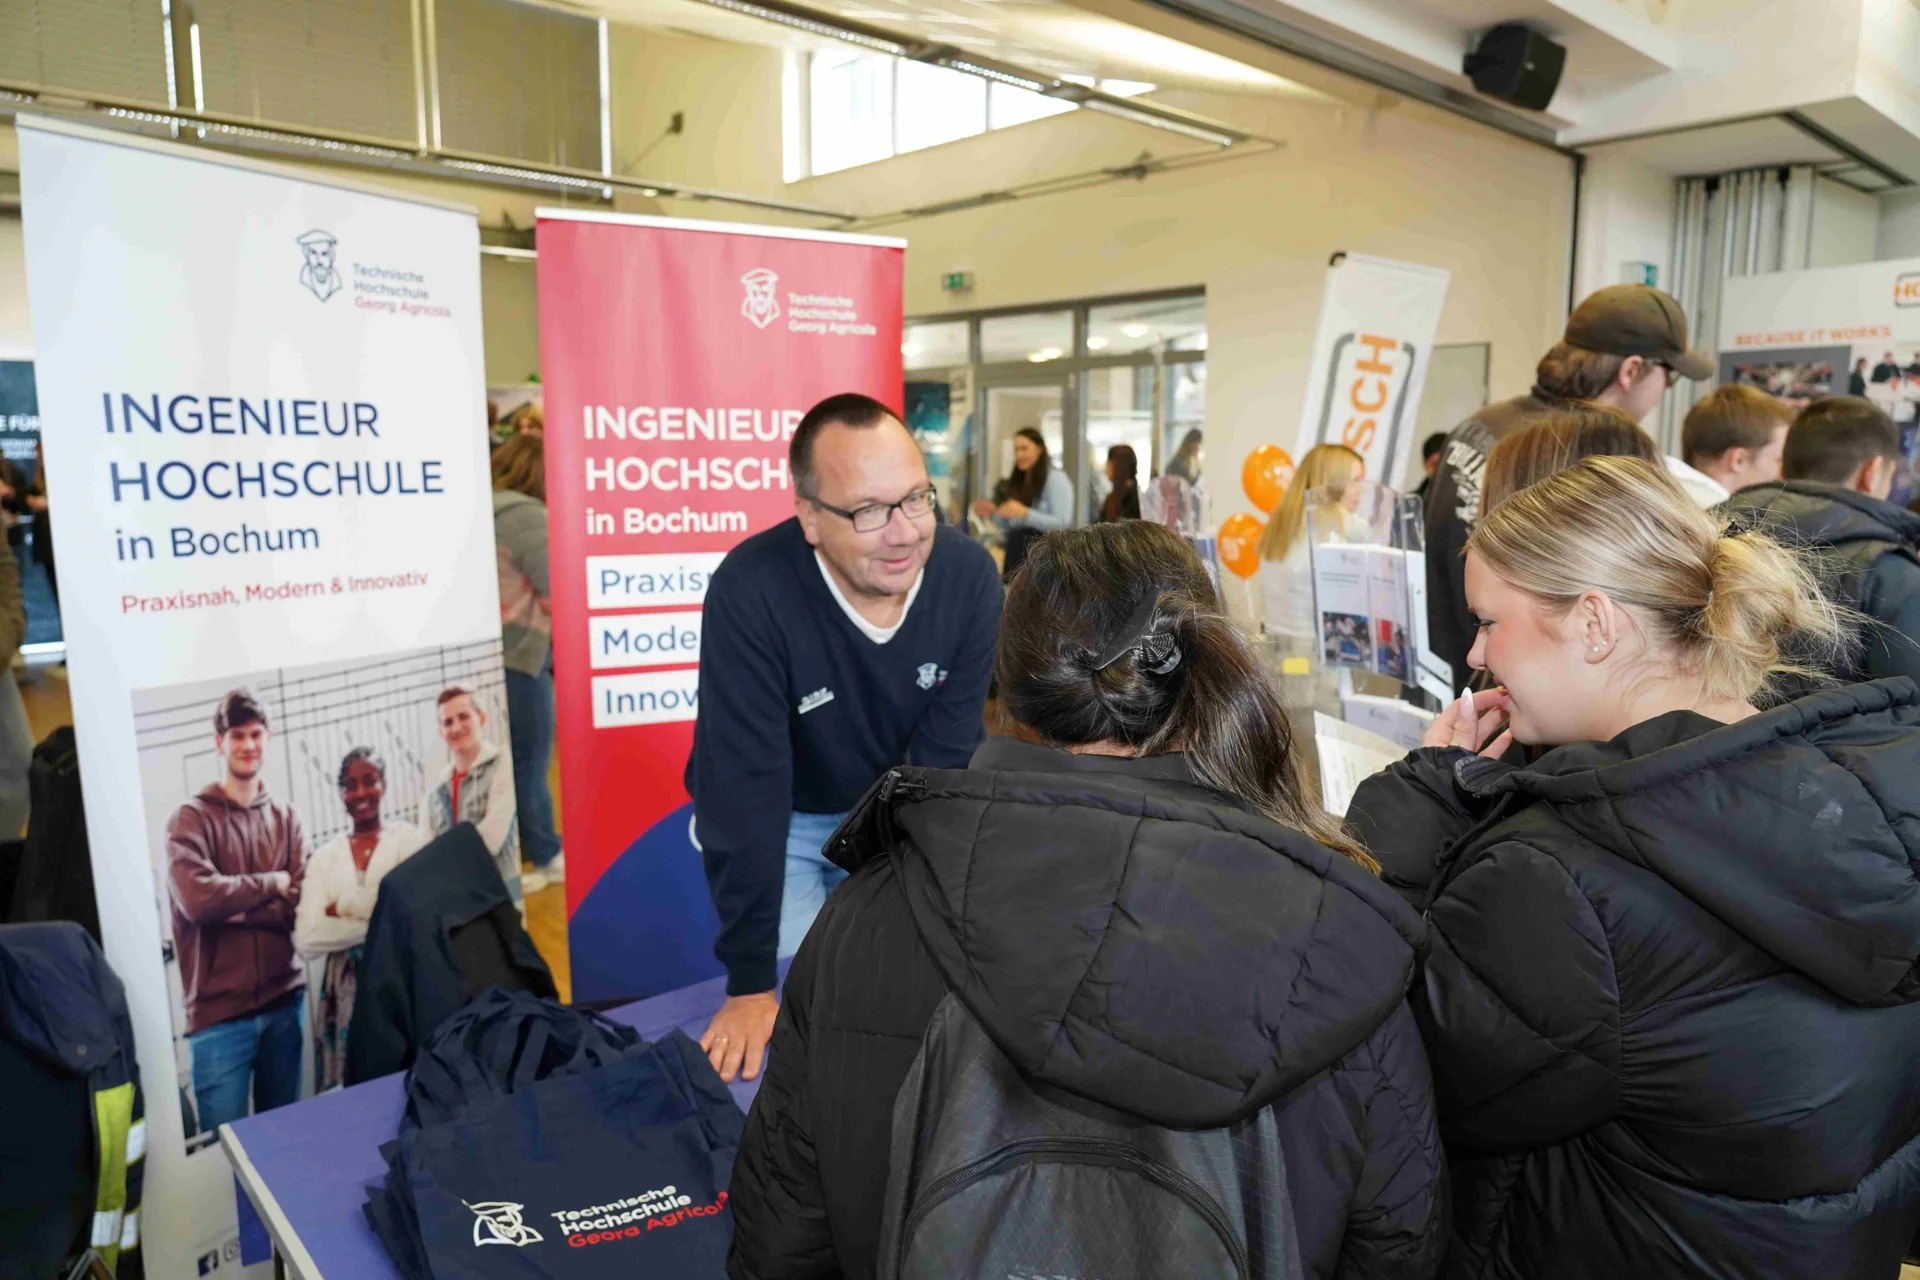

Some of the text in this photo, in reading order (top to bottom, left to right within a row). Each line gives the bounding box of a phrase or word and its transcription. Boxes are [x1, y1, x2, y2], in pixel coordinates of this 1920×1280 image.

[1342, 334, 1397, 453] SCH
[102, 392, 379, 438] INGENIEUR
[110, 461, 444, 502] HOCHSCHULE
[585, 457, 795, 491] HOCHSCH
[586, 505, 748, 535] in Bochum
[115, 523, 320, 560] in Bochum
[121, 569, 429, 613] Praxisnah, Modern & Innovativ
[601, 566, 713, 596] Praxis
[603, 625, 698, 655] Mode
[606, 688, 699, 715] Innov
[551, 1185, 677, 1222] Technische
[559, 1194, 692, 1236] Hochschule
